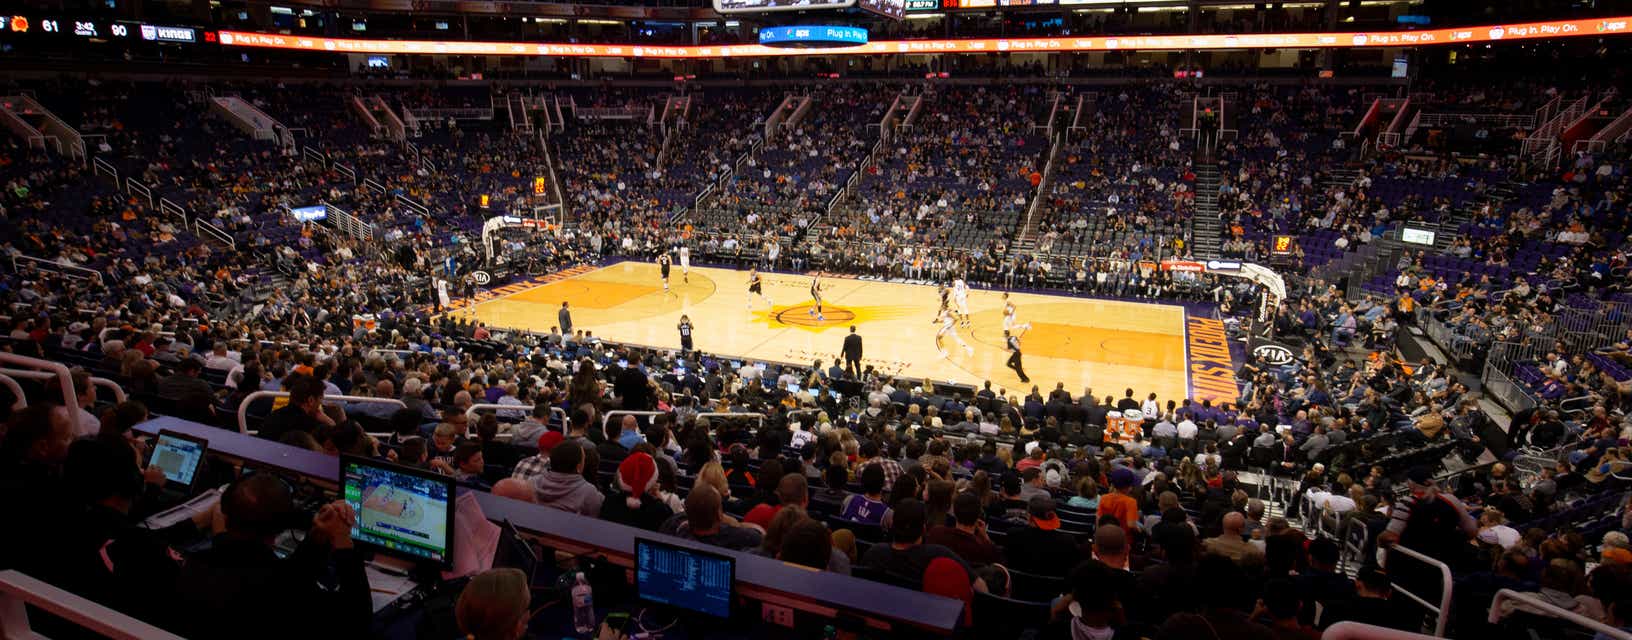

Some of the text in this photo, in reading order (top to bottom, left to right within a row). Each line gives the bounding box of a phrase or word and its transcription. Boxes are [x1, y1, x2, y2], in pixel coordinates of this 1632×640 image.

[42, 20, 58, 32] 61
[112, 24, 126, 36] 90
[1508, 27, 1527, 36] Plug
[1540, 24, 1560, 34] Play
[158, 28, 192, 40] KINGS
[827, 29, 843, 38] Plug
[1371, 35, 1389, 43] Plug
[1402, 34, 1420, 42] Play
[1188, 316, 1232, 367] PHOENIX
